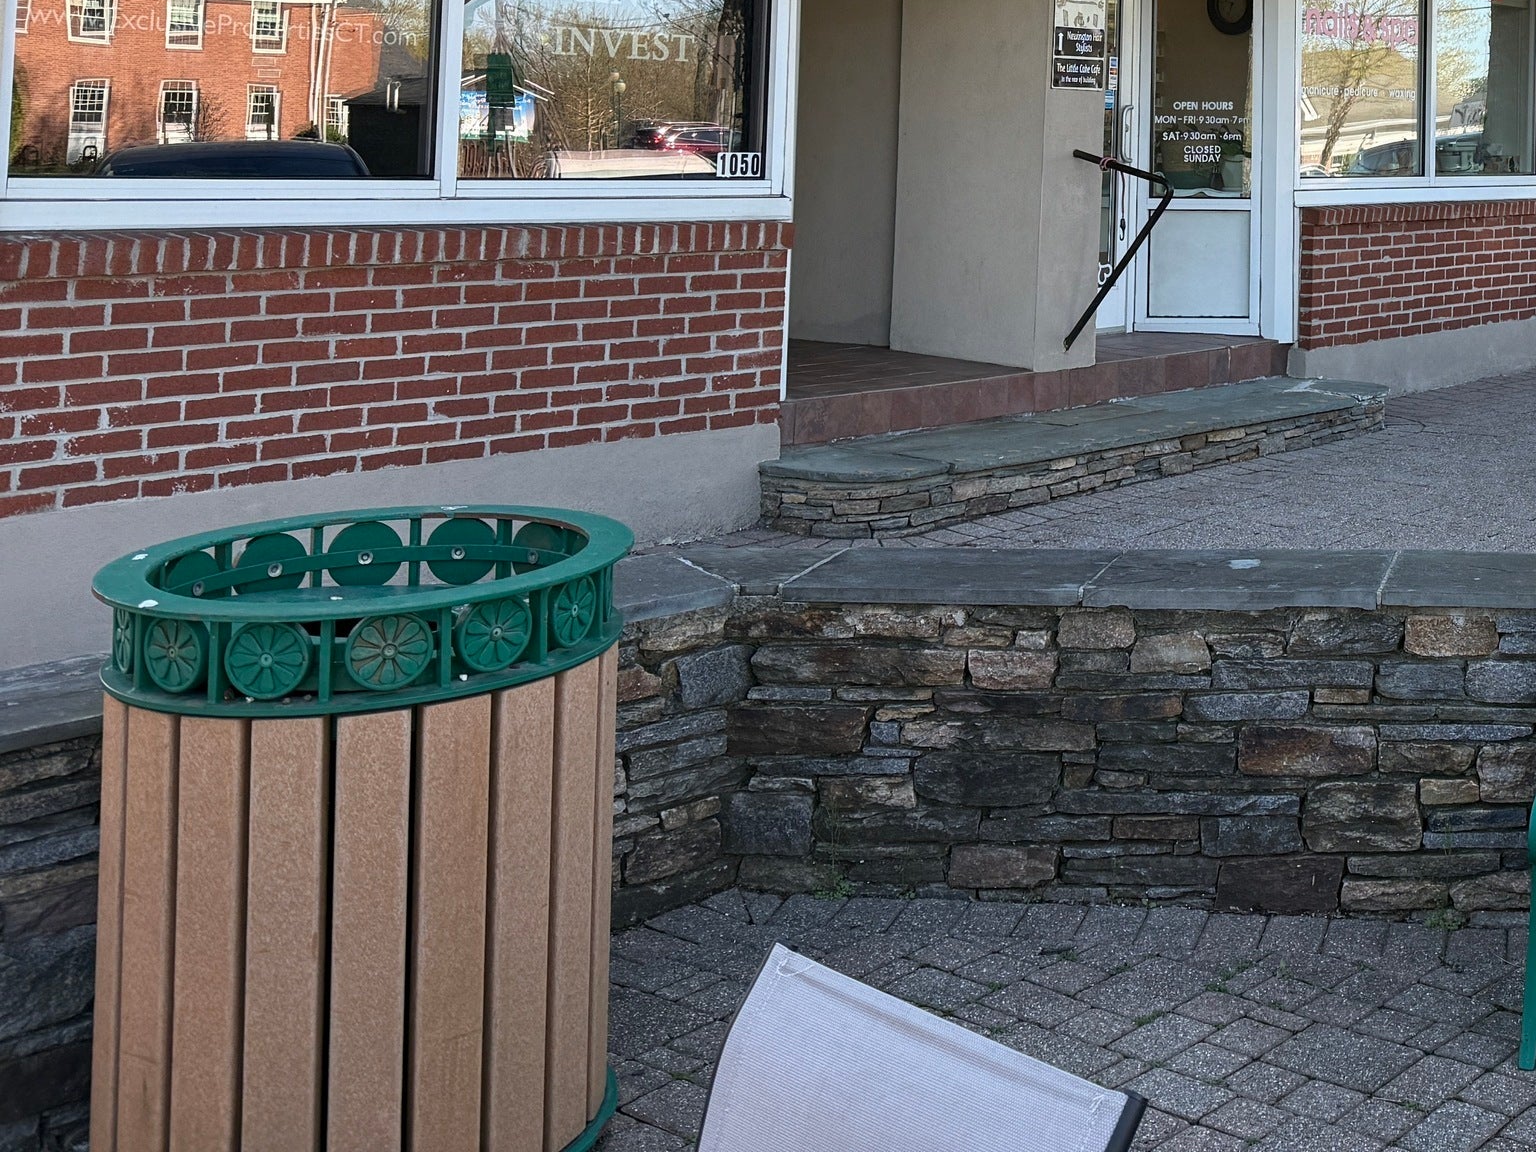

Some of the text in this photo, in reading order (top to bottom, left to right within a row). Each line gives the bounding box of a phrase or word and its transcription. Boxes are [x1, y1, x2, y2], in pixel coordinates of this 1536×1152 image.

[1305, 2, 1419, 52] nails & spa
[1067, 31, 1093, 43] Newington
[551, 26, 696, 62] INVEST
[1075, 42, 1093, 54] Stylists
[1056, 62, 1066, 73] The
[1066, 63, 1079, 73] Little
[1301, 83, 1417, 102] manicure pedicure waxing
[1173, 101, 1234, 111] OPEN HOURS
[1183, 145, 1222, 154] CLOSED
[720, 153, 760, 176] 1050
[1183, 154, 1221, 163] SUNDAY
